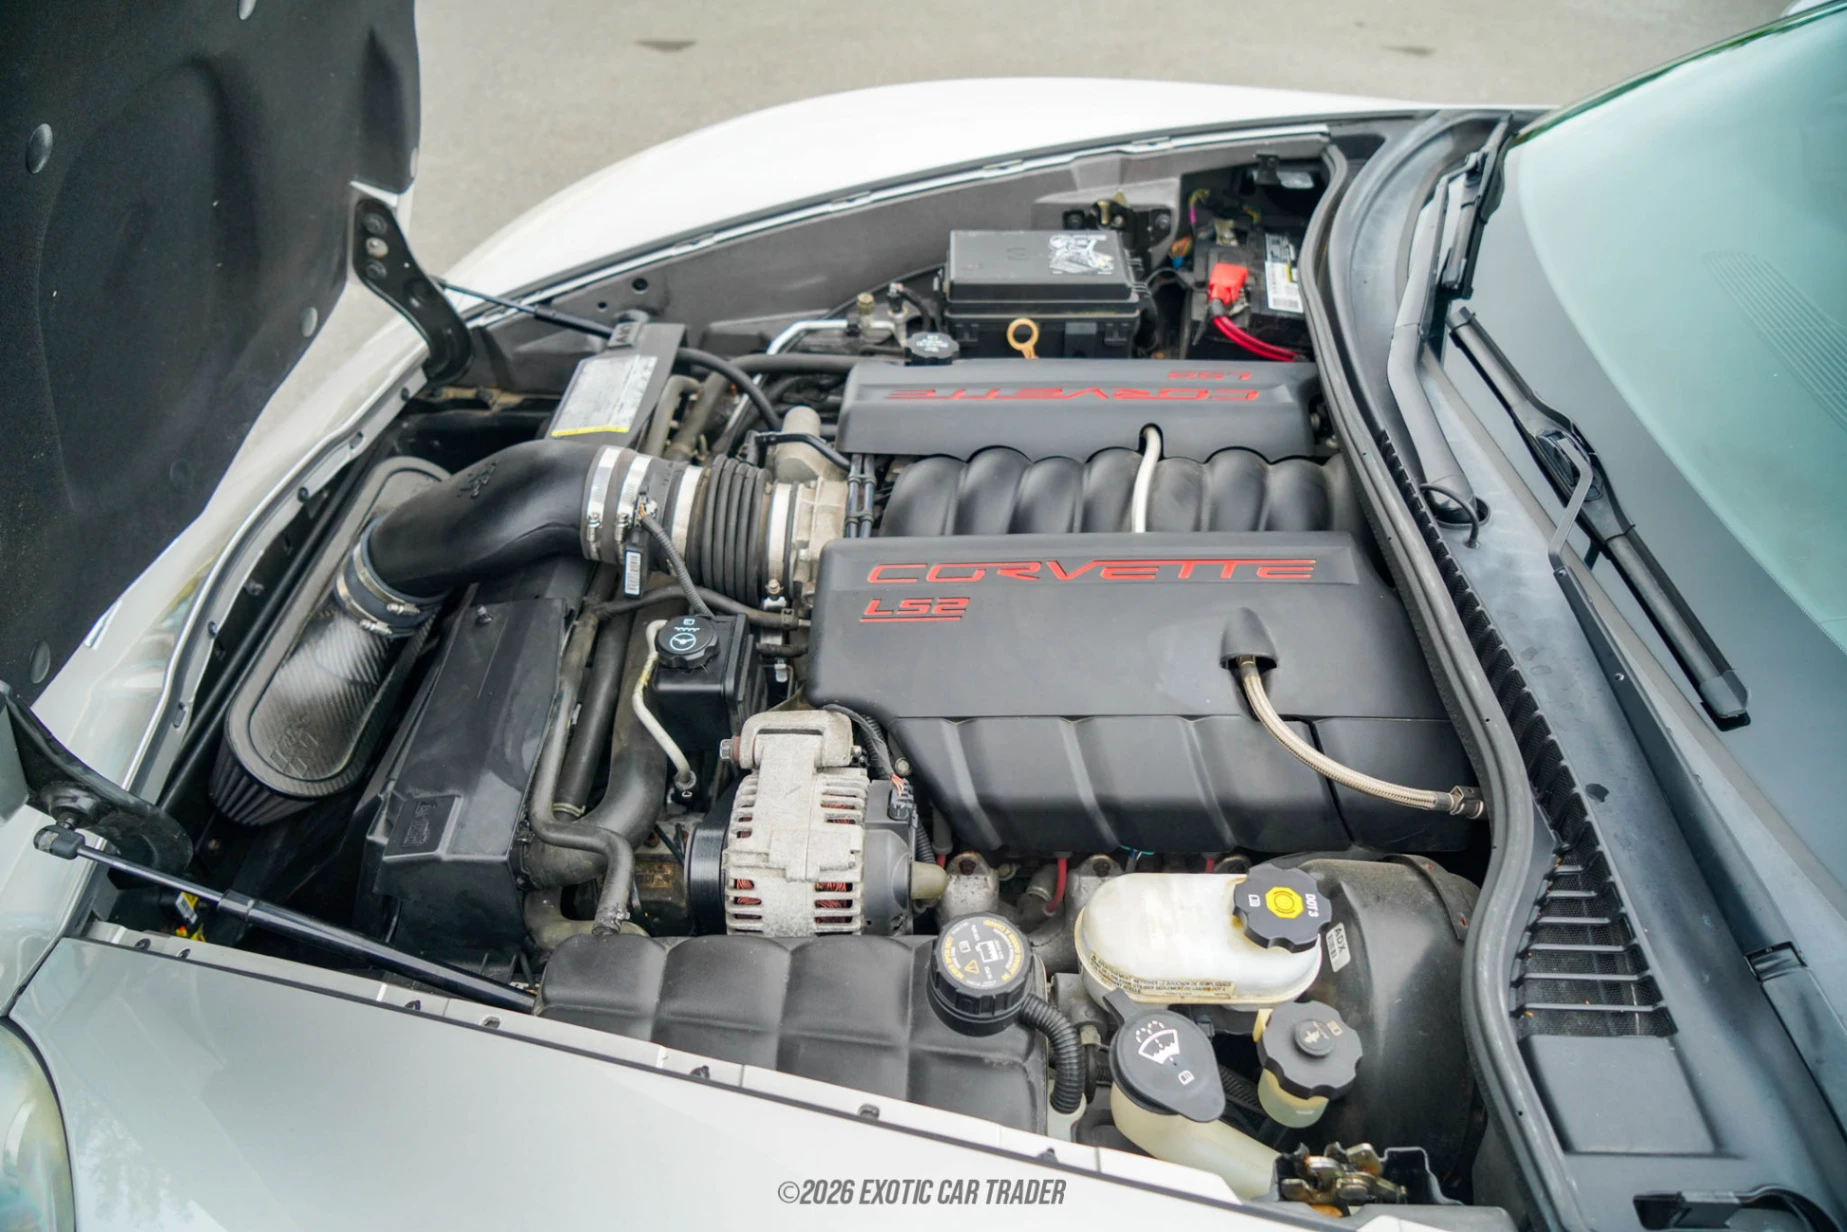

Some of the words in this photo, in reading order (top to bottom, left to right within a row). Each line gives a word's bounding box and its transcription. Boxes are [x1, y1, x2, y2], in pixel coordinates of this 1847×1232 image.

[884, 387, 1259, 400] CORVETTE
[867, 558, 1317, 583] CORVETTE
[863, 597, 970, 615] LS2
[1334, 928, 1346, 953] ADX
